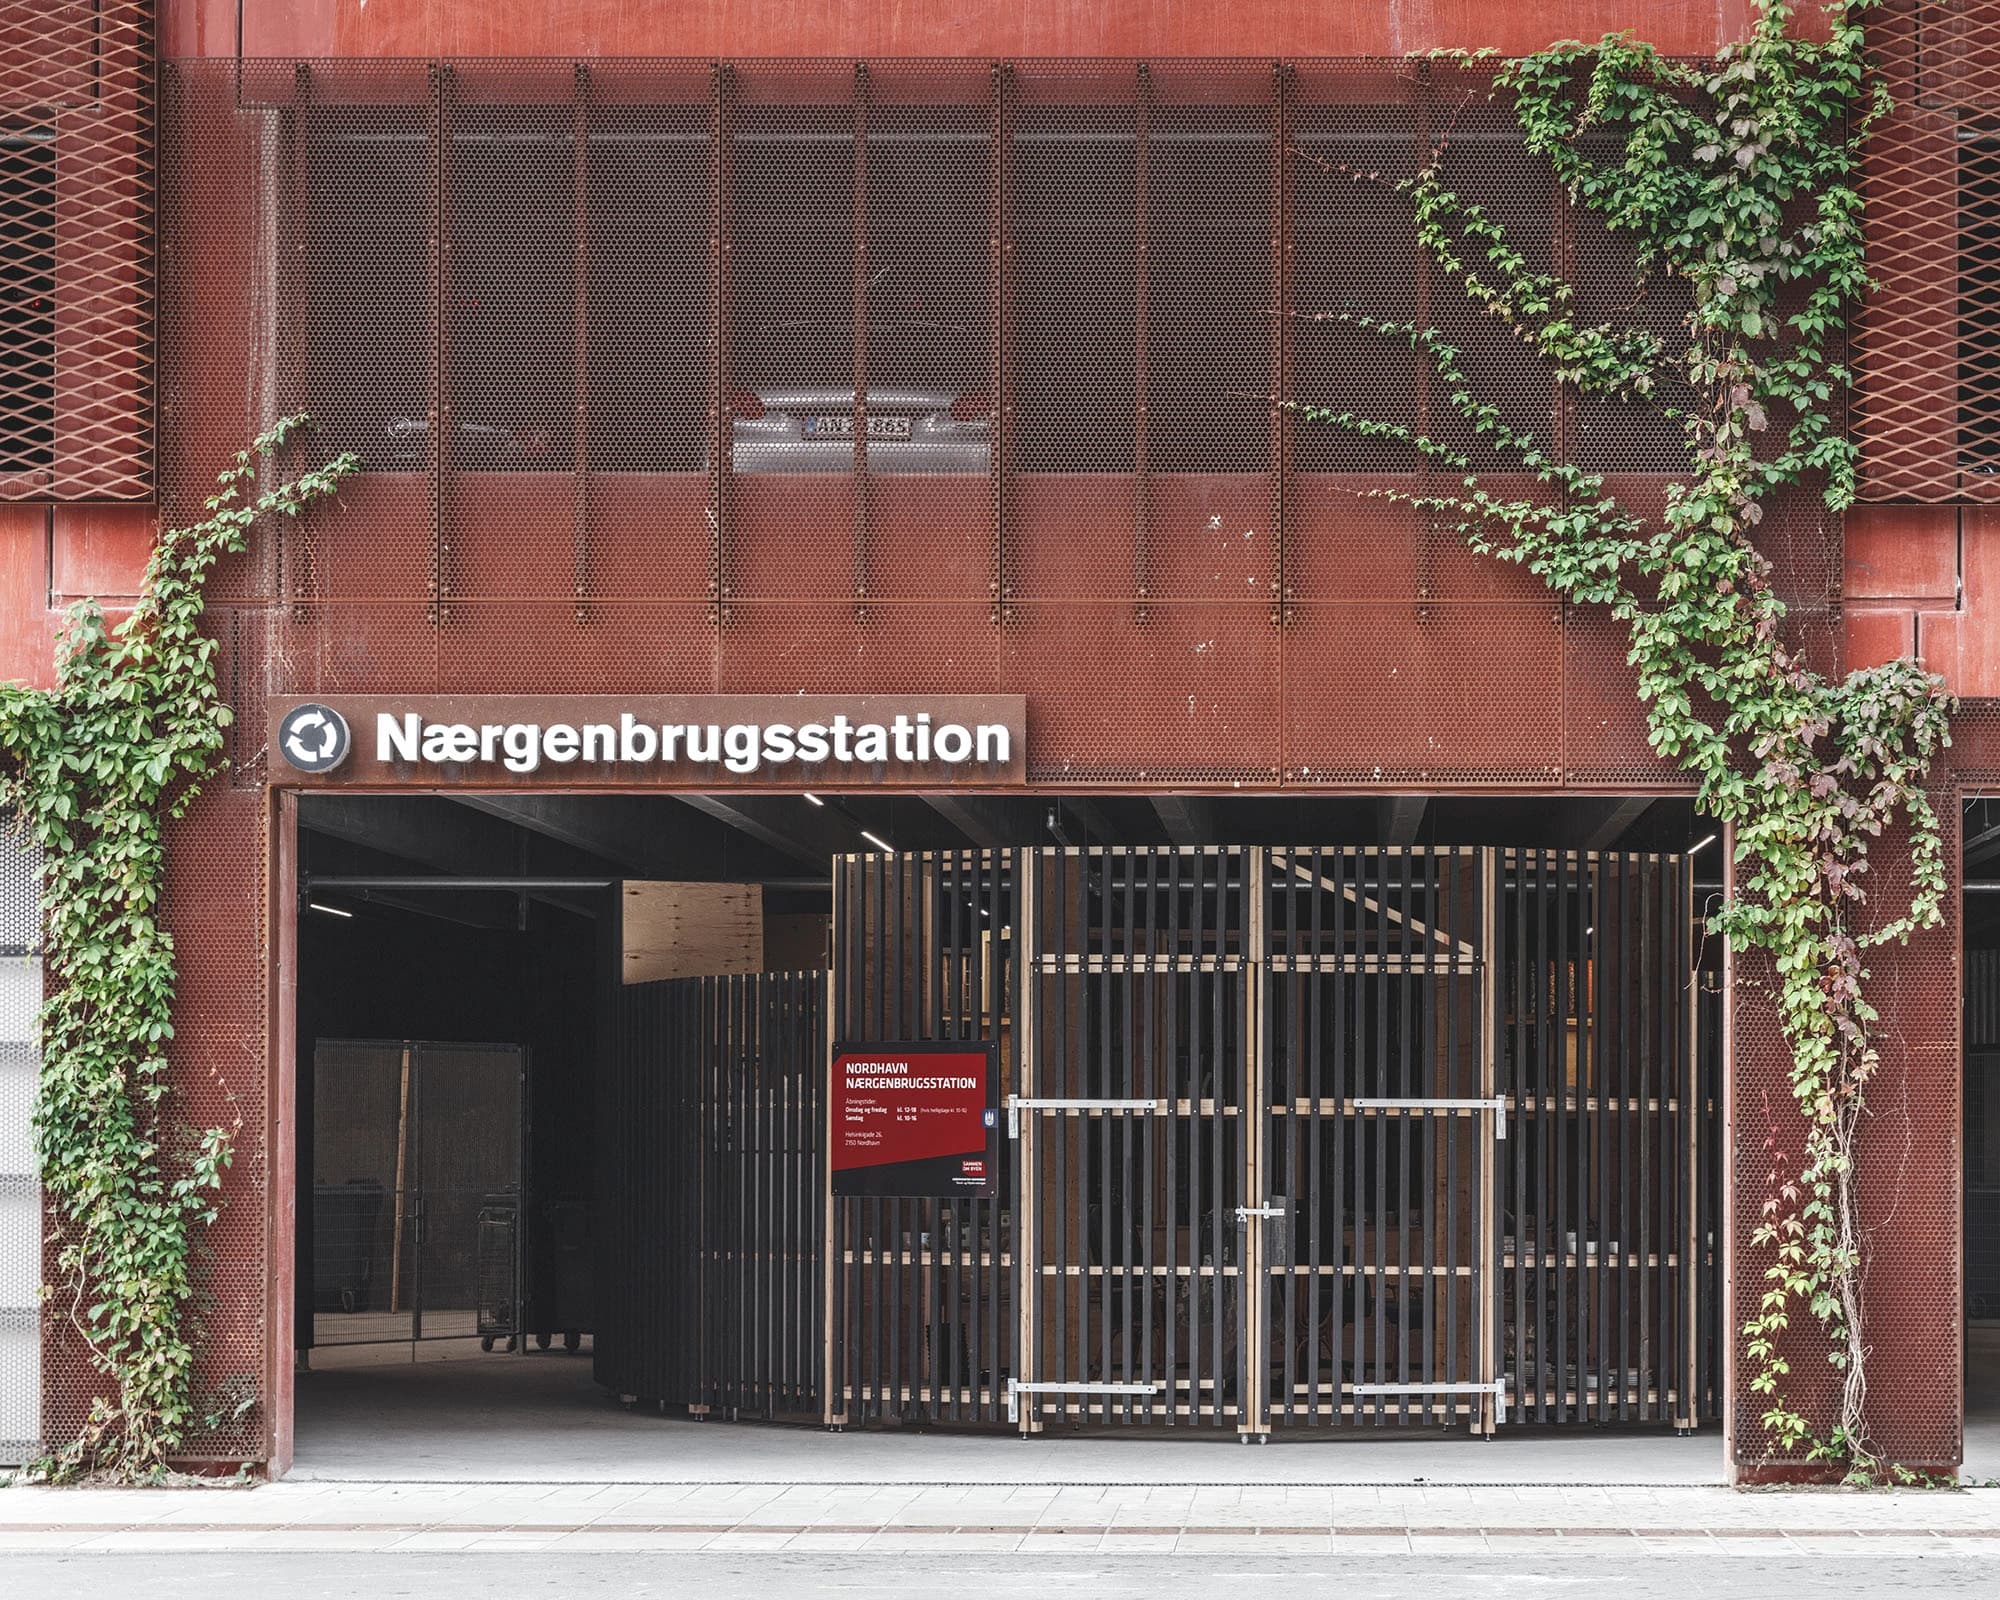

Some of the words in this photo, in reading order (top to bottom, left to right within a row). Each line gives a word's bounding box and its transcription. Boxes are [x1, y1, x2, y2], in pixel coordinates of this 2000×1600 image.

[376, 712, 1011, 774] Nærgenbrugsstation
[845, 1062, 908, 1074] NORDHAVN
[845, 1077, 977, 1089] NÆRGENBRUGSSTATION
